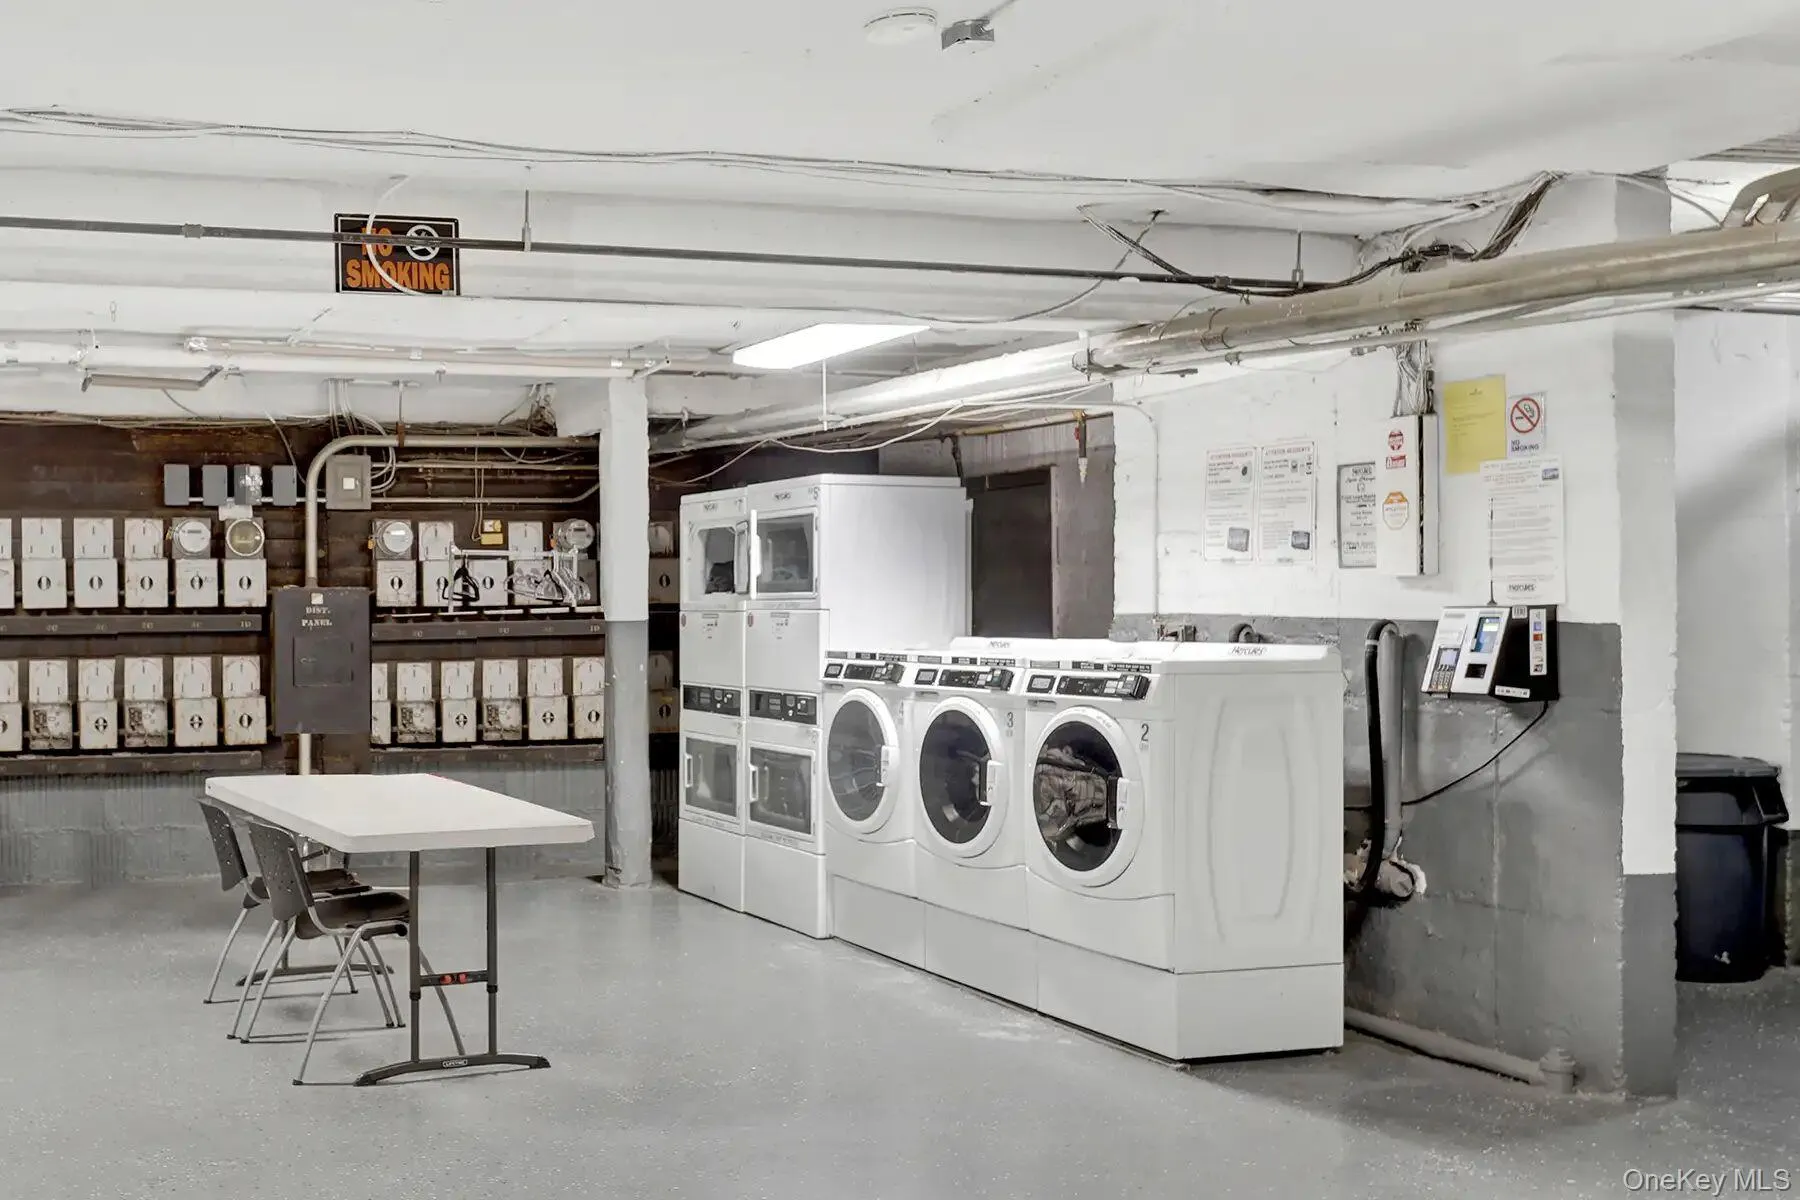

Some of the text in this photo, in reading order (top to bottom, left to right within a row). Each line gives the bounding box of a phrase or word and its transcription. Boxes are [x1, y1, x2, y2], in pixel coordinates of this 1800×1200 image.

[346, 258, 450, 290] SMOKING
[1511, 444, 1539, 452] SMOKING
[301, 618, 332, 627] PANEL
[1006, 711, 1014, 728] 3
[1140, 723, 1149, 742] 2
